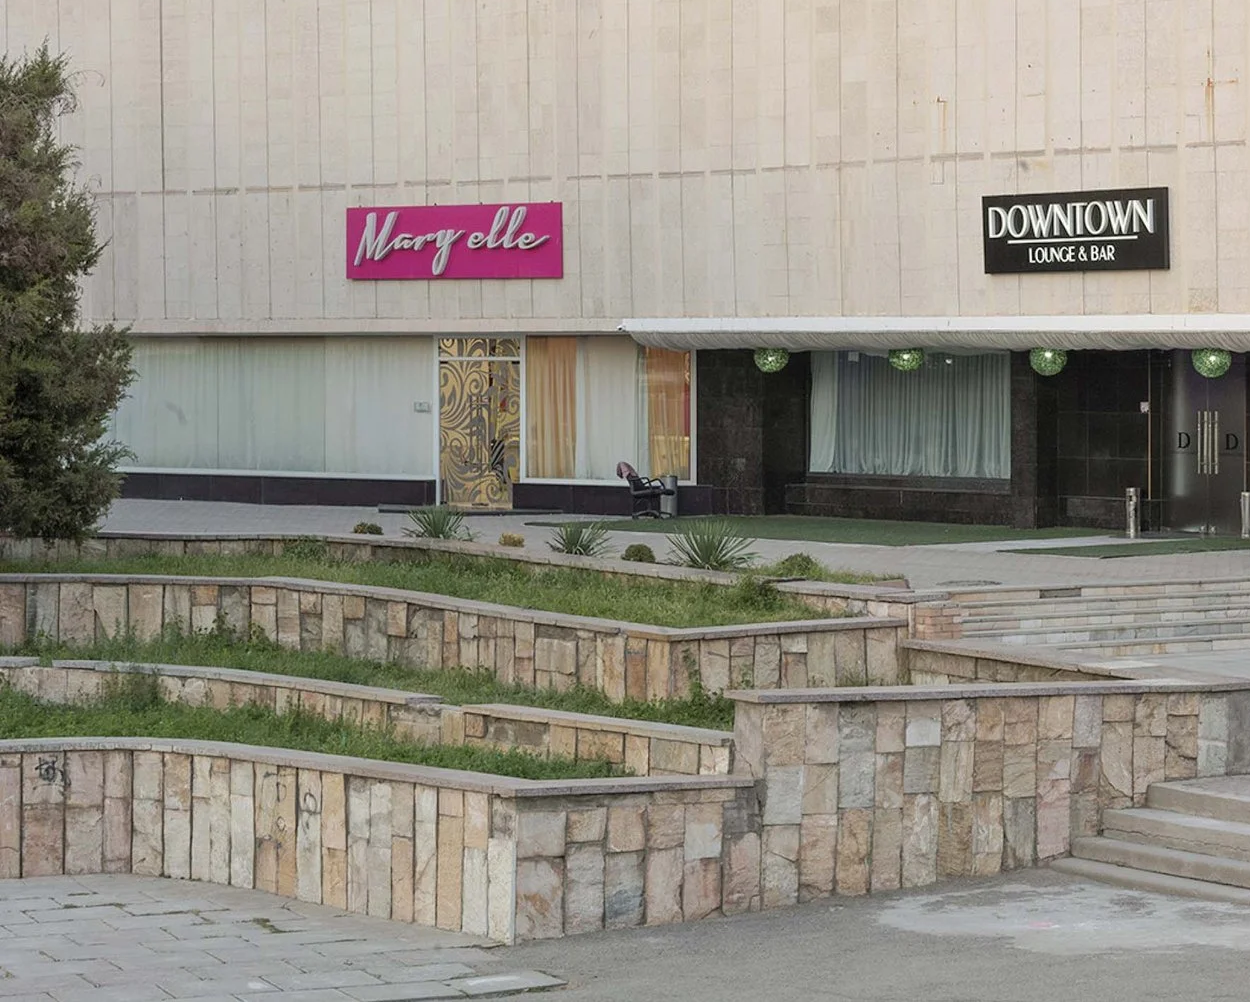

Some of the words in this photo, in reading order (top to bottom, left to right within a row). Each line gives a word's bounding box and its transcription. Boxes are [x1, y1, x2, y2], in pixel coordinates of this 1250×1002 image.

[988, 199, 1154, 238] DOWNTOWN
[354, 211, 465, 276] Mary
[467, 206, 550, 250] elle
[1029, 246, 1075, 263] LOUNGE
[1078, 246, 1087, 262] &
[1091, 245, 1115, 261] BAR
[1178, 432, 1190, 448] D
[1226, 433, 1239, 450] D
